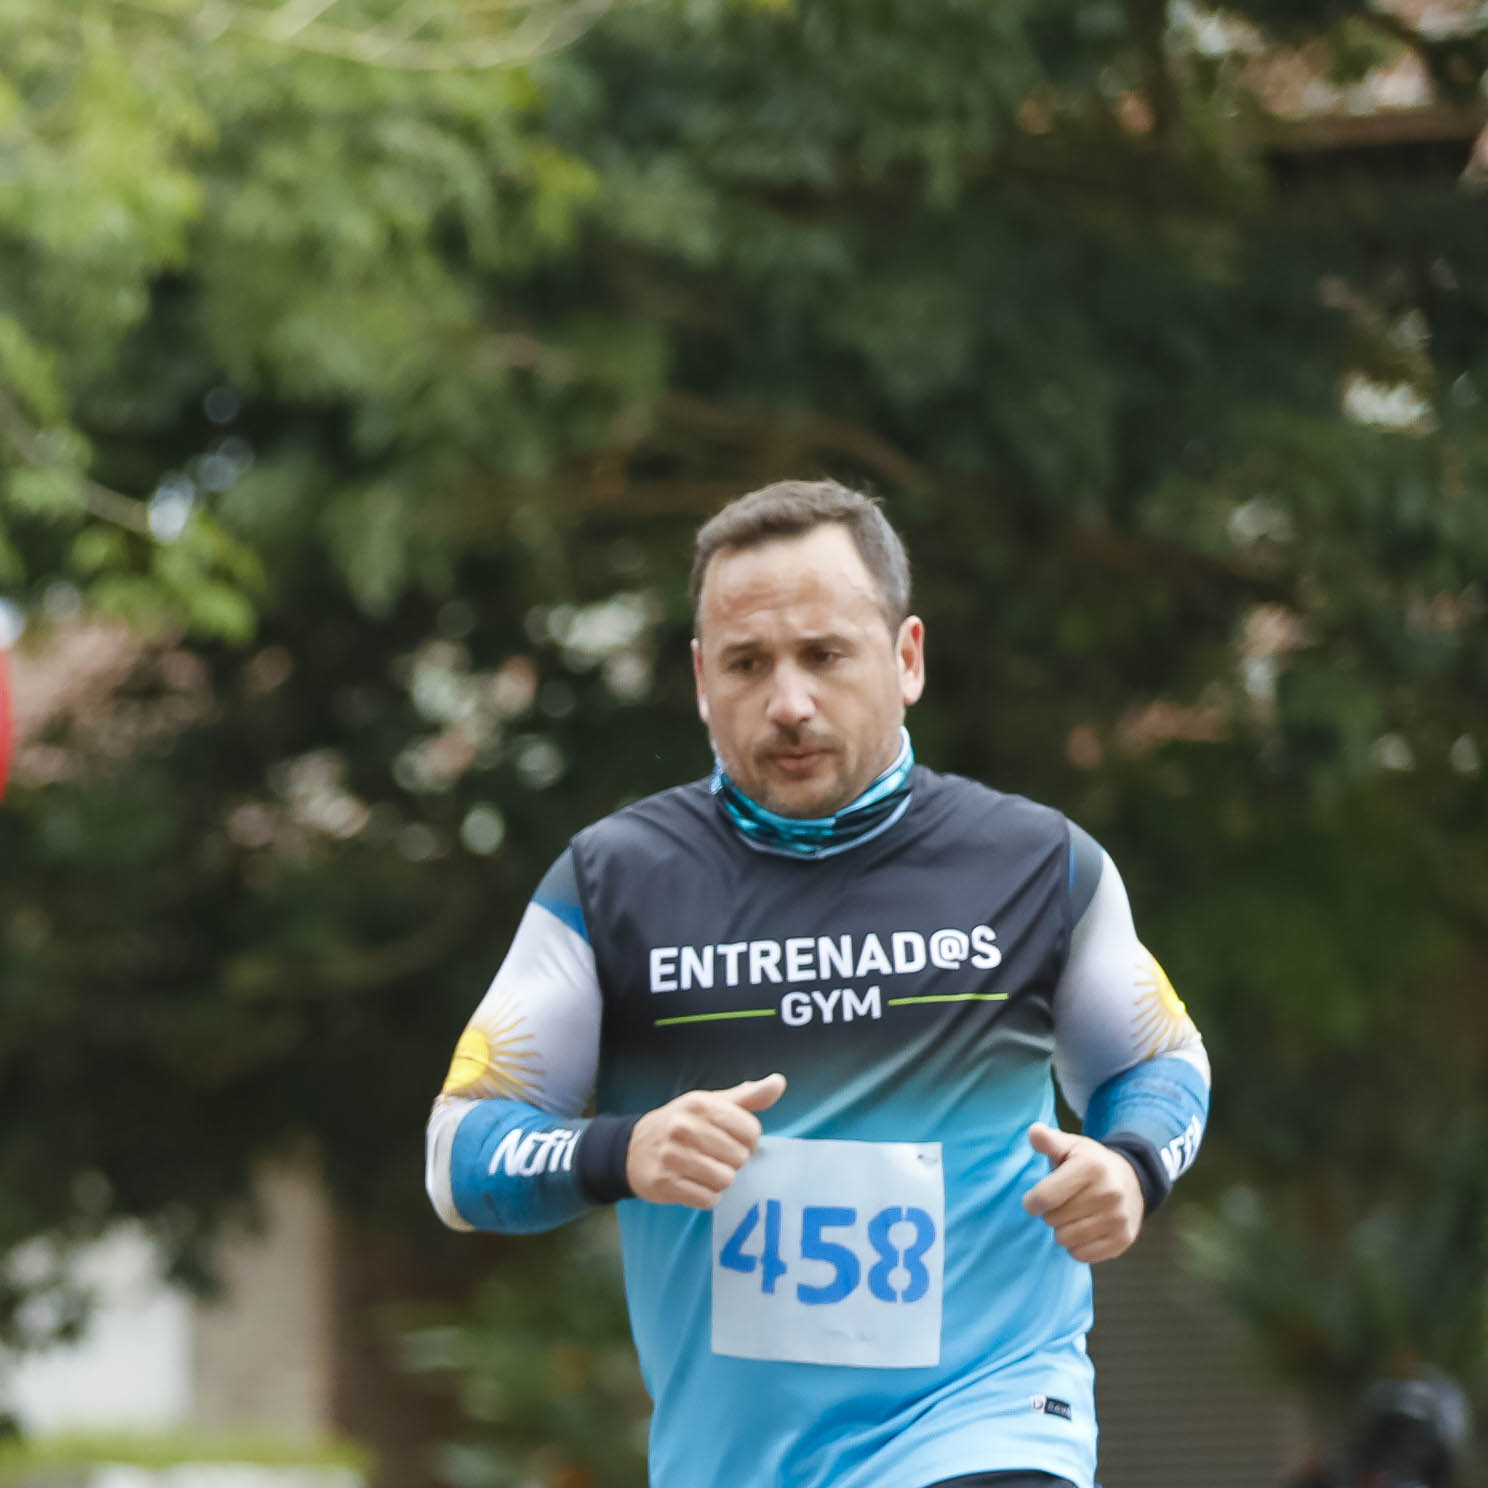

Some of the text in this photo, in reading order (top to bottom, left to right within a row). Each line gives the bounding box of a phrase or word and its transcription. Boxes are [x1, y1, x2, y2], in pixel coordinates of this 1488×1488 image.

[649, 924, 1003, 994] ENTRENAD@S
[780, 985, 882, 1027] GYM
[718, 1198, 936, 1306] 458
